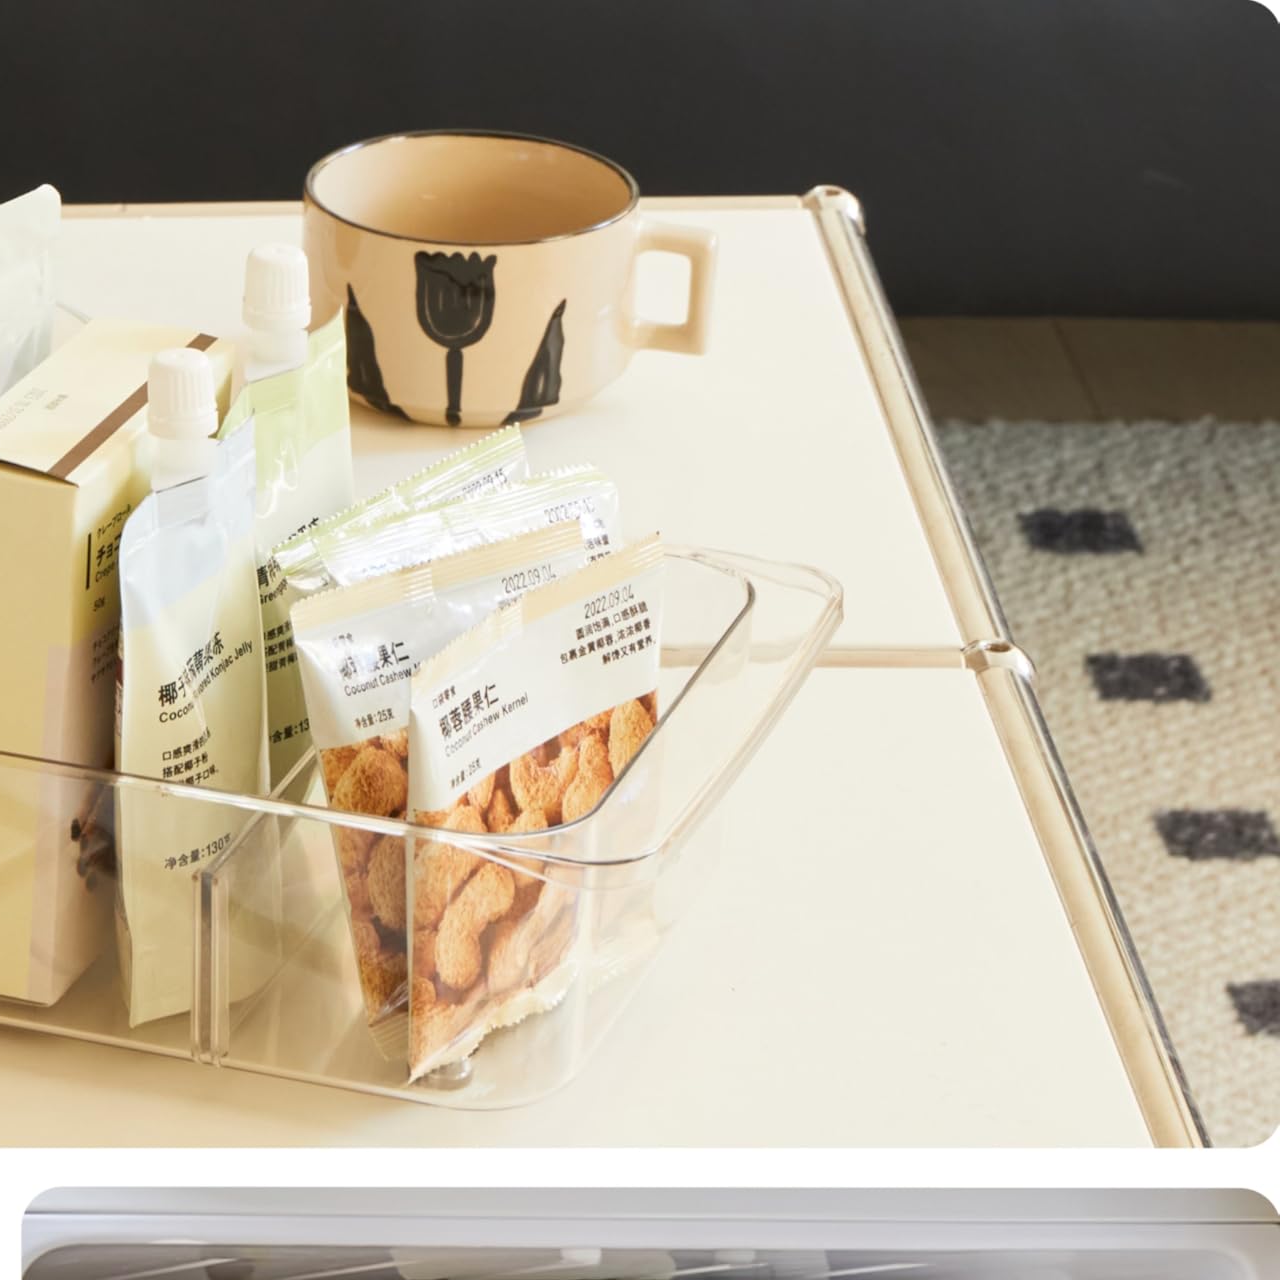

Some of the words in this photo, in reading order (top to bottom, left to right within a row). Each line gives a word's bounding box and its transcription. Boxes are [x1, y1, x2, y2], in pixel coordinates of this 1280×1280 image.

[501, 564, 557, 594] 2022.09.04
[584, 584, 635, 619] 2022.09.04
[234, 640, 253, 661] Jelly
[344, 677, 380, 697] Coconut
[380, 667, 412, 687] Cashew
[502, 691, 529, 717] Kernel
